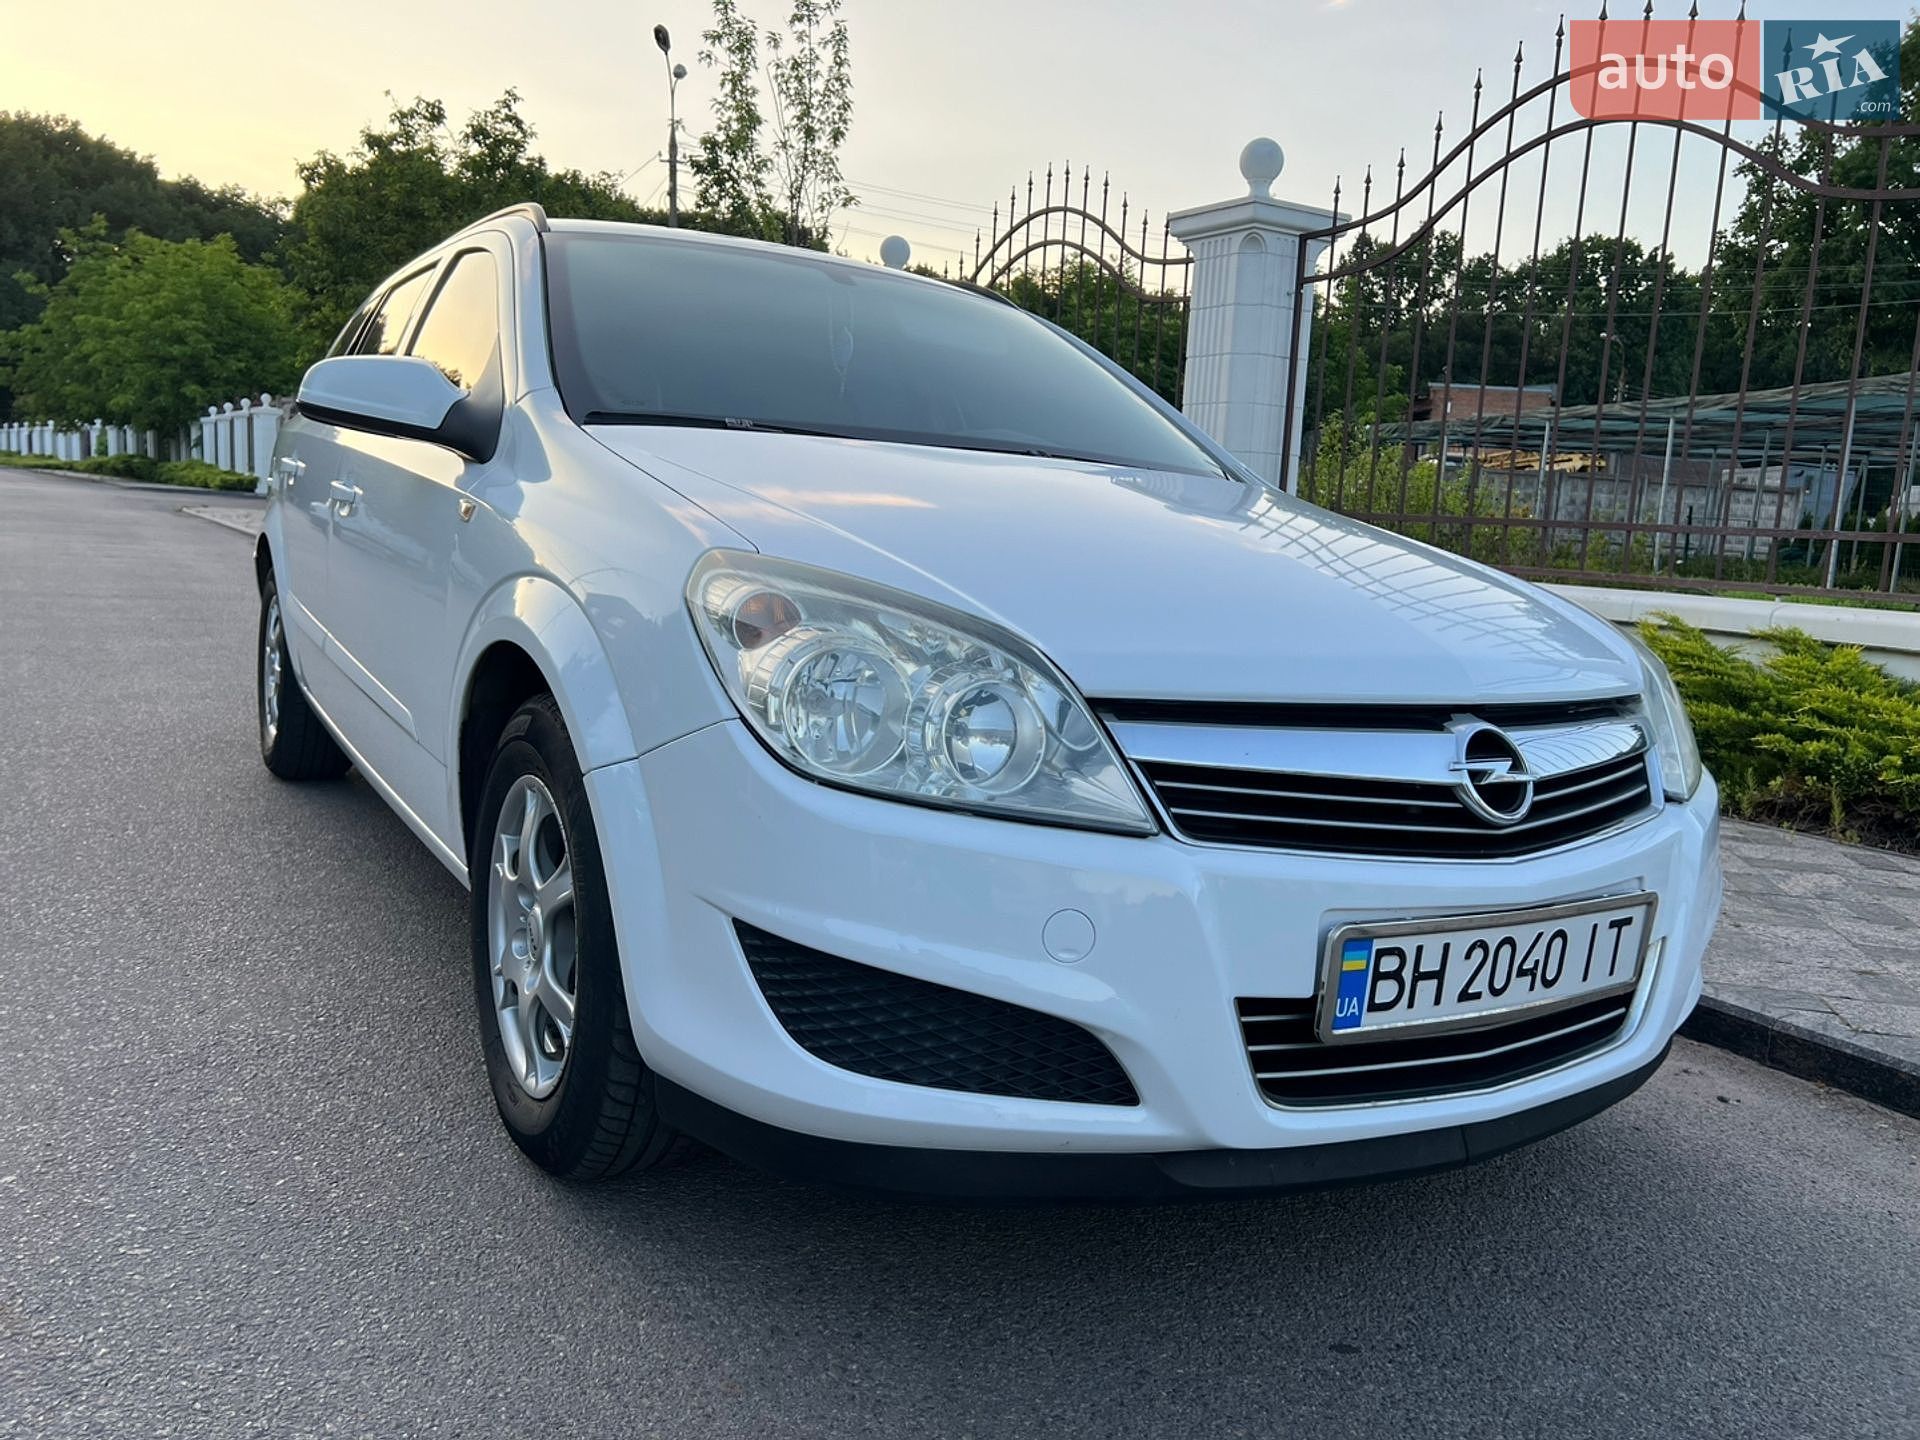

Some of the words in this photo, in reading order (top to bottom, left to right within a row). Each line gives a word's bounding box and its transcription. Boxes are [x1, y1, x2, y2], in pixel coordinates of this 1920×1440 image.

[1367, 942, 1451, 1013] BH
[1457, 928, 1568, 1002] 2040
[1582, 916, 1634, 982] IT
[1335, 997, 1360, 1018] UA
